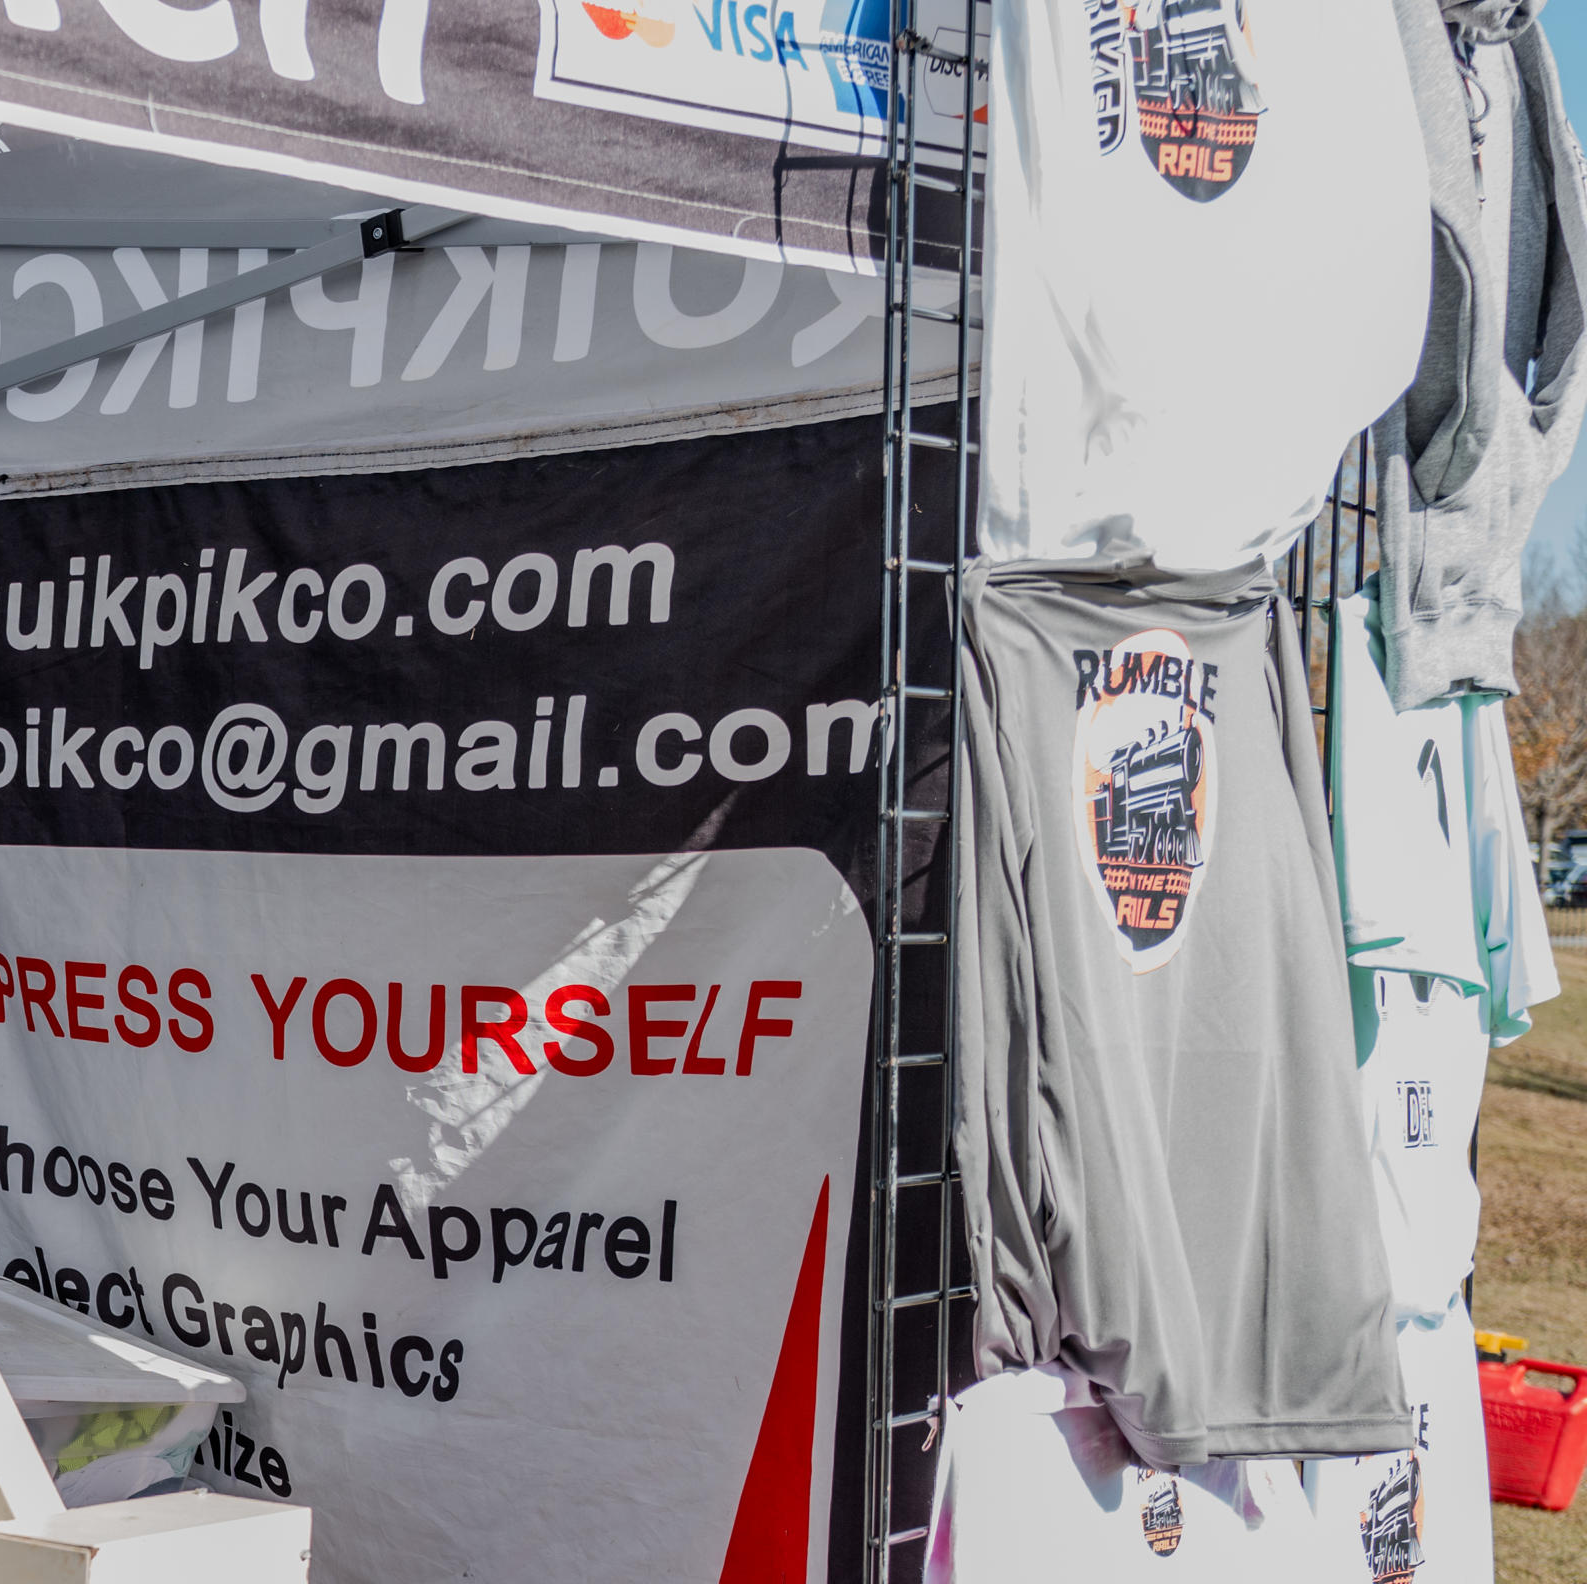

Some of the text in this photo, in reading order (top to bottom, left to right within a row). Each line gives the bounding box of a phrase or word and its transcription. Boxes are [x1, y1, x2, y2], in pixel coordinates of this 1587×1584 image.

[693, 0, 810, 72] VISA
[1157, 142, 1234, 182] RAILS
[1073, 648, 1219, 725] RUMBLE
[251, 973, 803, 1078] YOURSELF
[186, 1156, 348, 1250] Your
[362, 1184, 678, 1285] Apparel
[162, 1272, 466, 1403] Graphics
